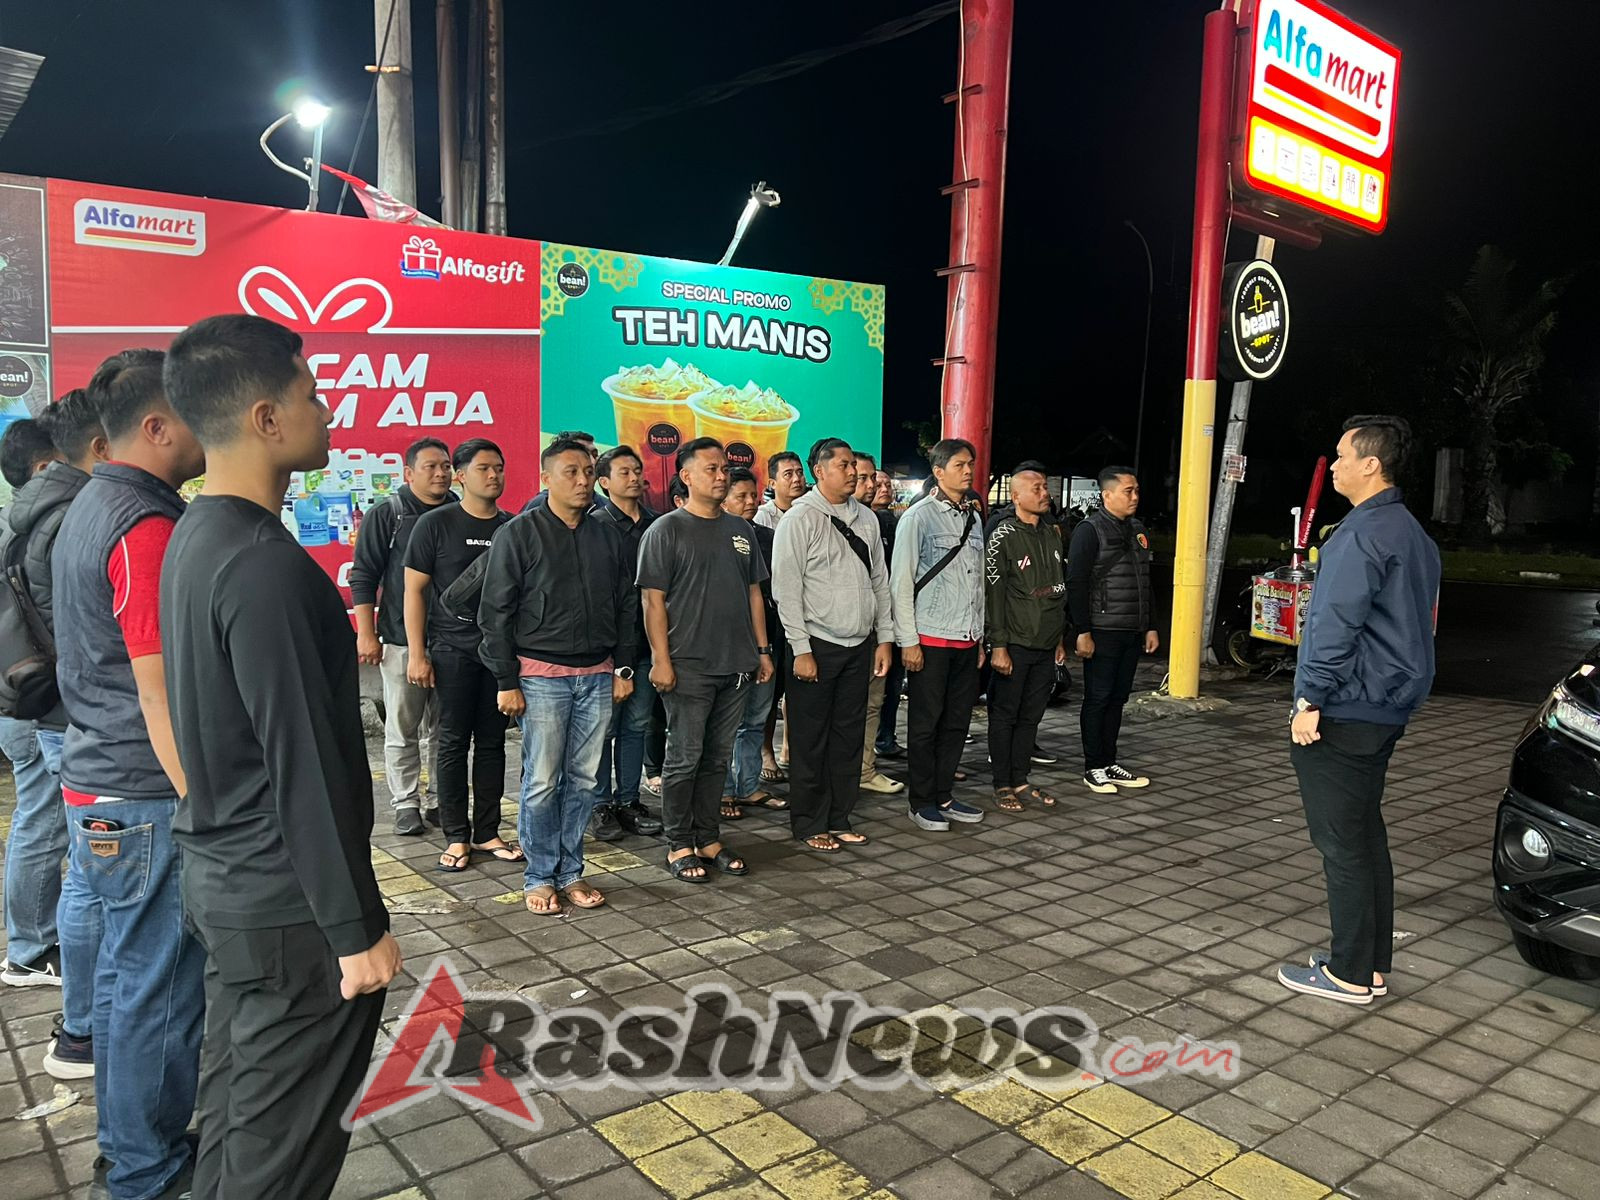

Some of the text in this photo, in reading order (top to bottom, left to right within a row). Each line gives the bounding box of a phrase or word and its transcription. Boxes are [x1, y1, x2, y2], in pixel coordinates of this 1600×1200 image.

[1263, 8, 1387, 110] Alfamart
[83, 205, 196, 235] Alfamart
[441, 256, 526, 284] Alfagift
[559, 273, 586, 286] bean!
[662, 281, 792, 312] SPECIAL PROMO
[613, 306, 831, 363] TEH MANIS
[1239, 300, 1280, 339] bean!
[0, 371, 28, 383] ean!
[306, 353, 429, 389] CAM
[316, 391, 494, 429] M ADA
[650, 434, 677, 444] bean!
[727, 452, 752, 462] bean!
